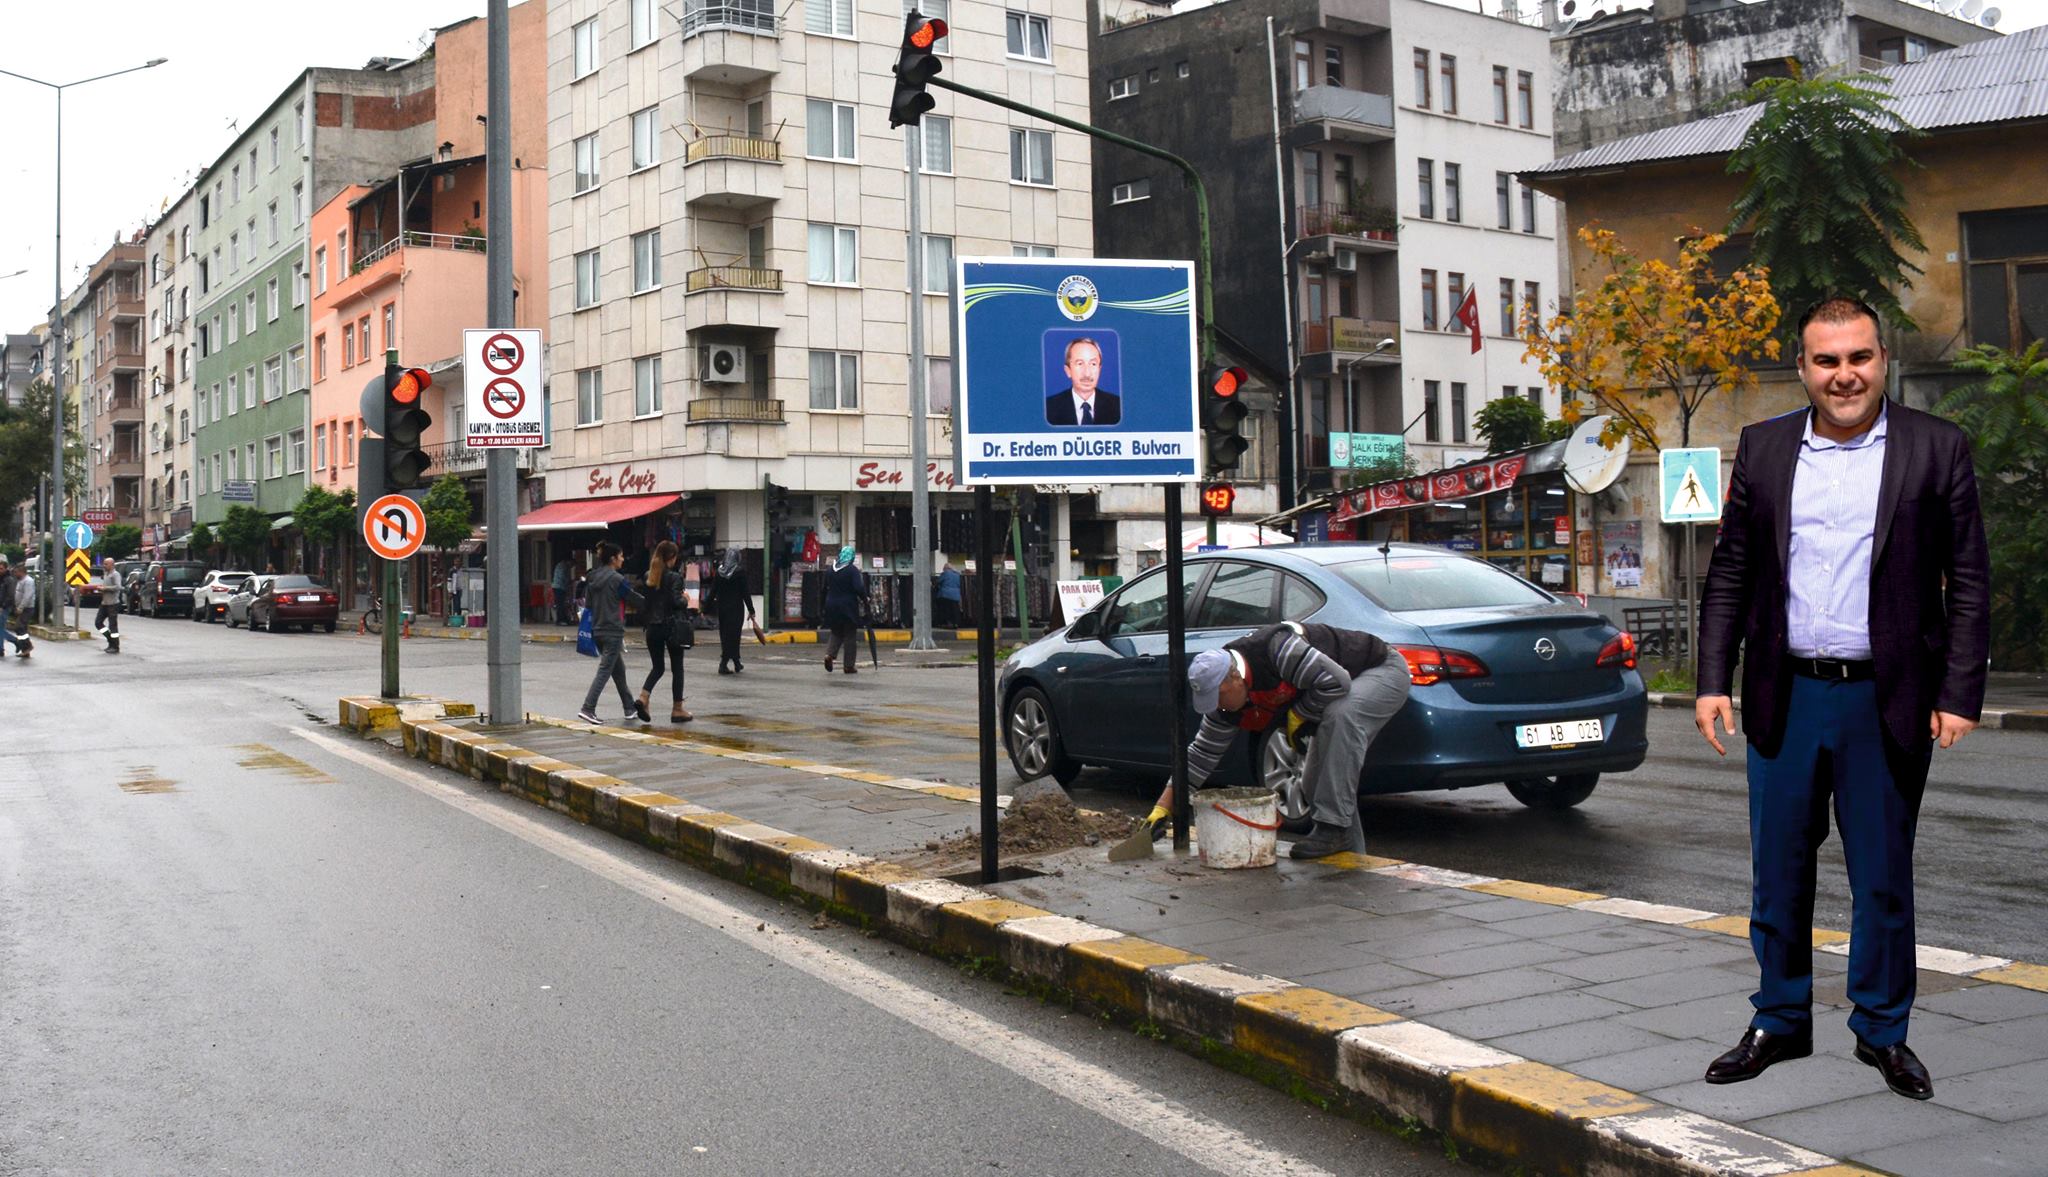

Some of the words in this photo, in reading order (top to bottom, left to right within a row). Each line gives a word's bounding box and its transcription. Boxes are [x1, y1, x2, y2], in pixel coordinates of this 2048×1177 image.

[469, 422, 491, 434] KAMYON
[495, 422, 517, 434] OTOBÜS
[517, 421, 541, 434] GİREMEZ
[983, 441, 1004, 457] Dr.
[1010, 441, 1057, 457] Erdem
[1063, 436, 1122, 457] DÜLGER
[1132, 439, 1181, 456] Bulvarı
[1352, 443, 1371, 453] HALK
[588, 468, 612, 494] Sen
[856, 462, 904, 488] Sen
[1206, 489, 1229, 508] 43
[1061, 584, 1081, 594] PARK
[1082, 582, 1101, 593] BÜFE
[1526, 727, 1540, 744] 61
[1550, 725, 1564, 742] AB
[1578, 722, 1600, 739] 026
